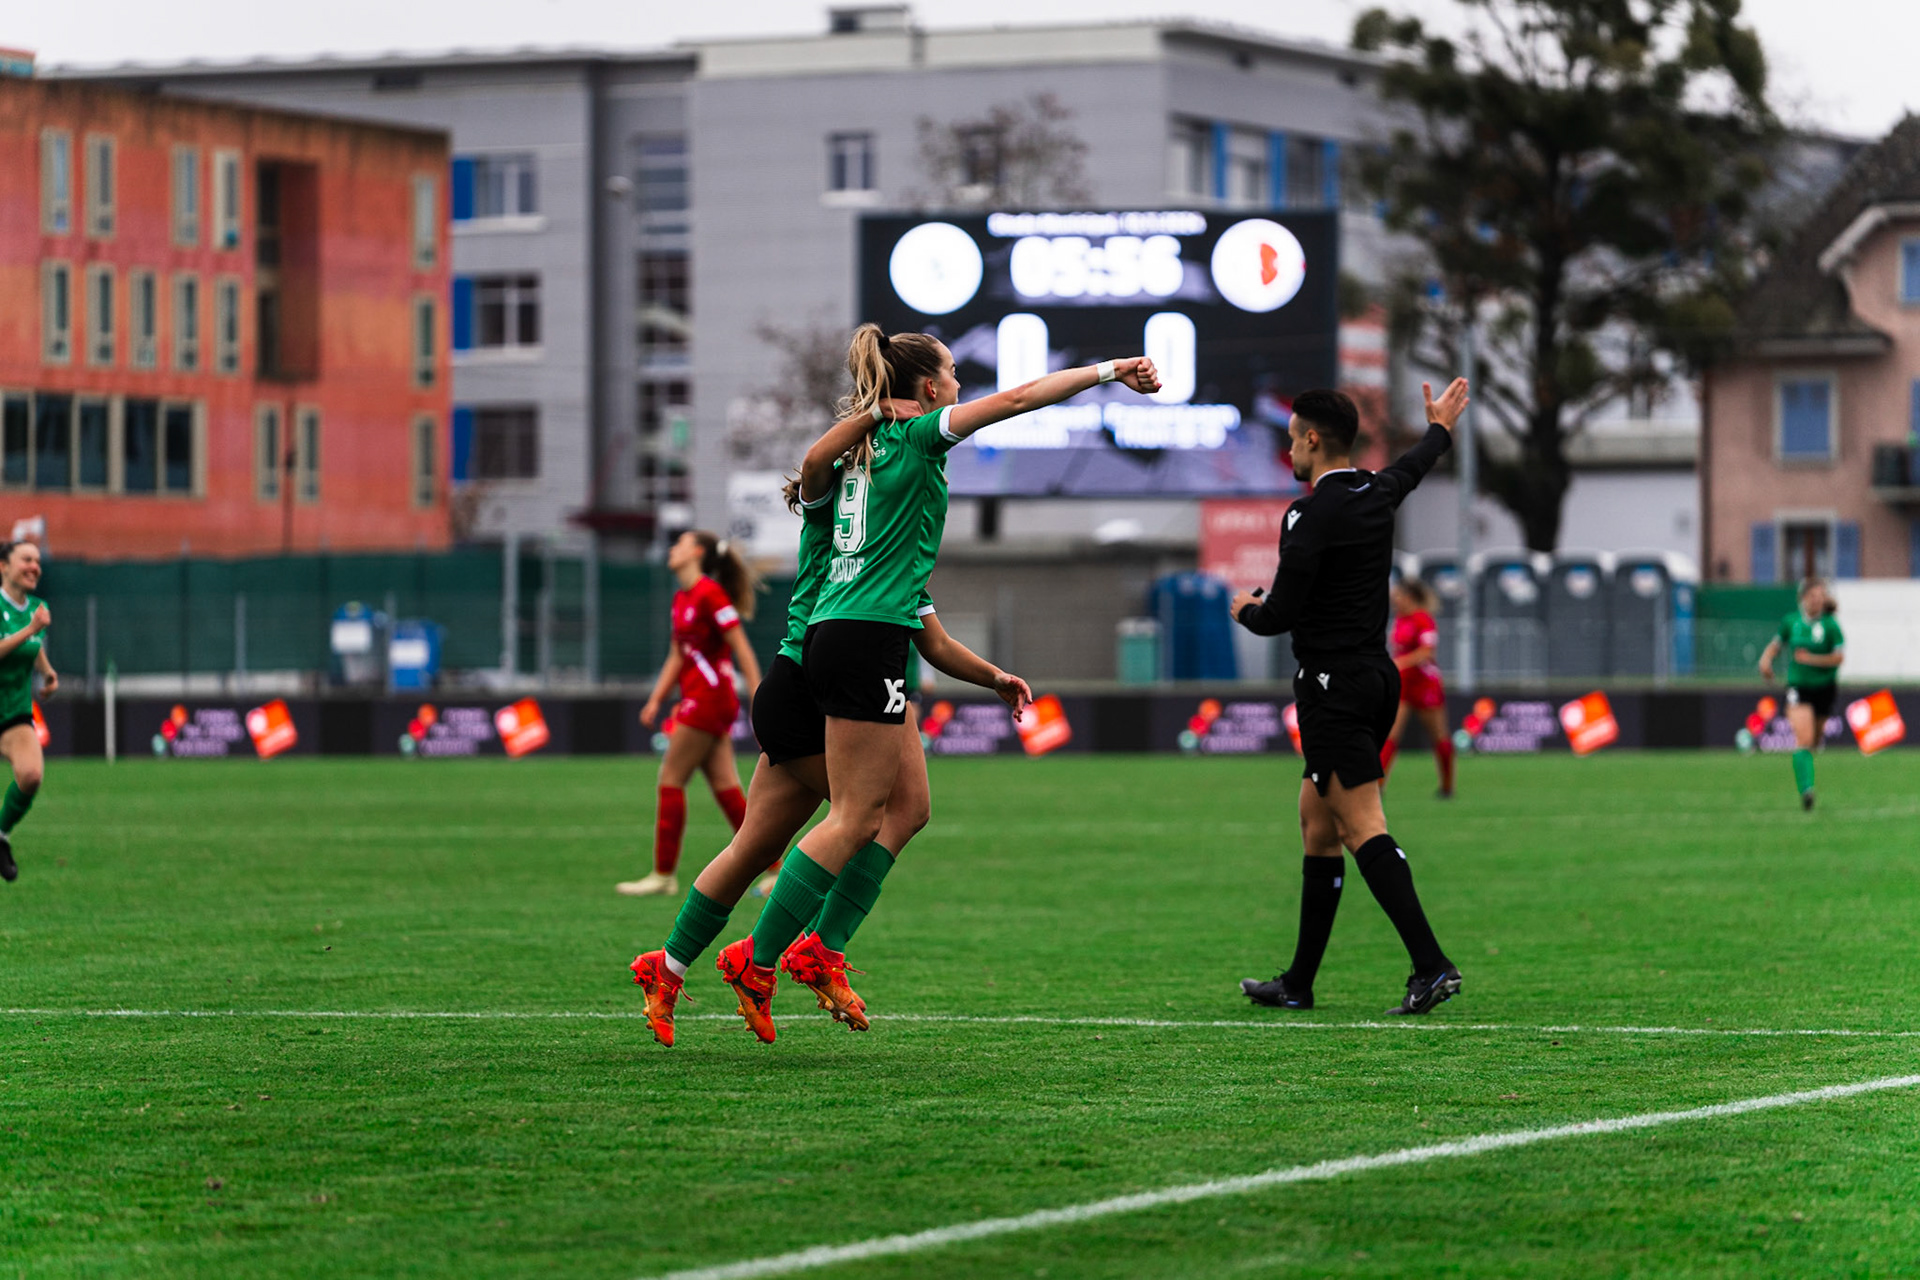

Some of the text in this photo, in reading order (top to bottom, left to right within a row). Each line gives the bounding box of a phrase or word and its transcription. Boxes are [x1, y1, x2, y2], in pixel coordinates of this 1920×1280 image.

[1011, 235, 1183, 297] 05:56
[1144, 311, 1196, 404] 0
[833, 463, 869, 557] 9
